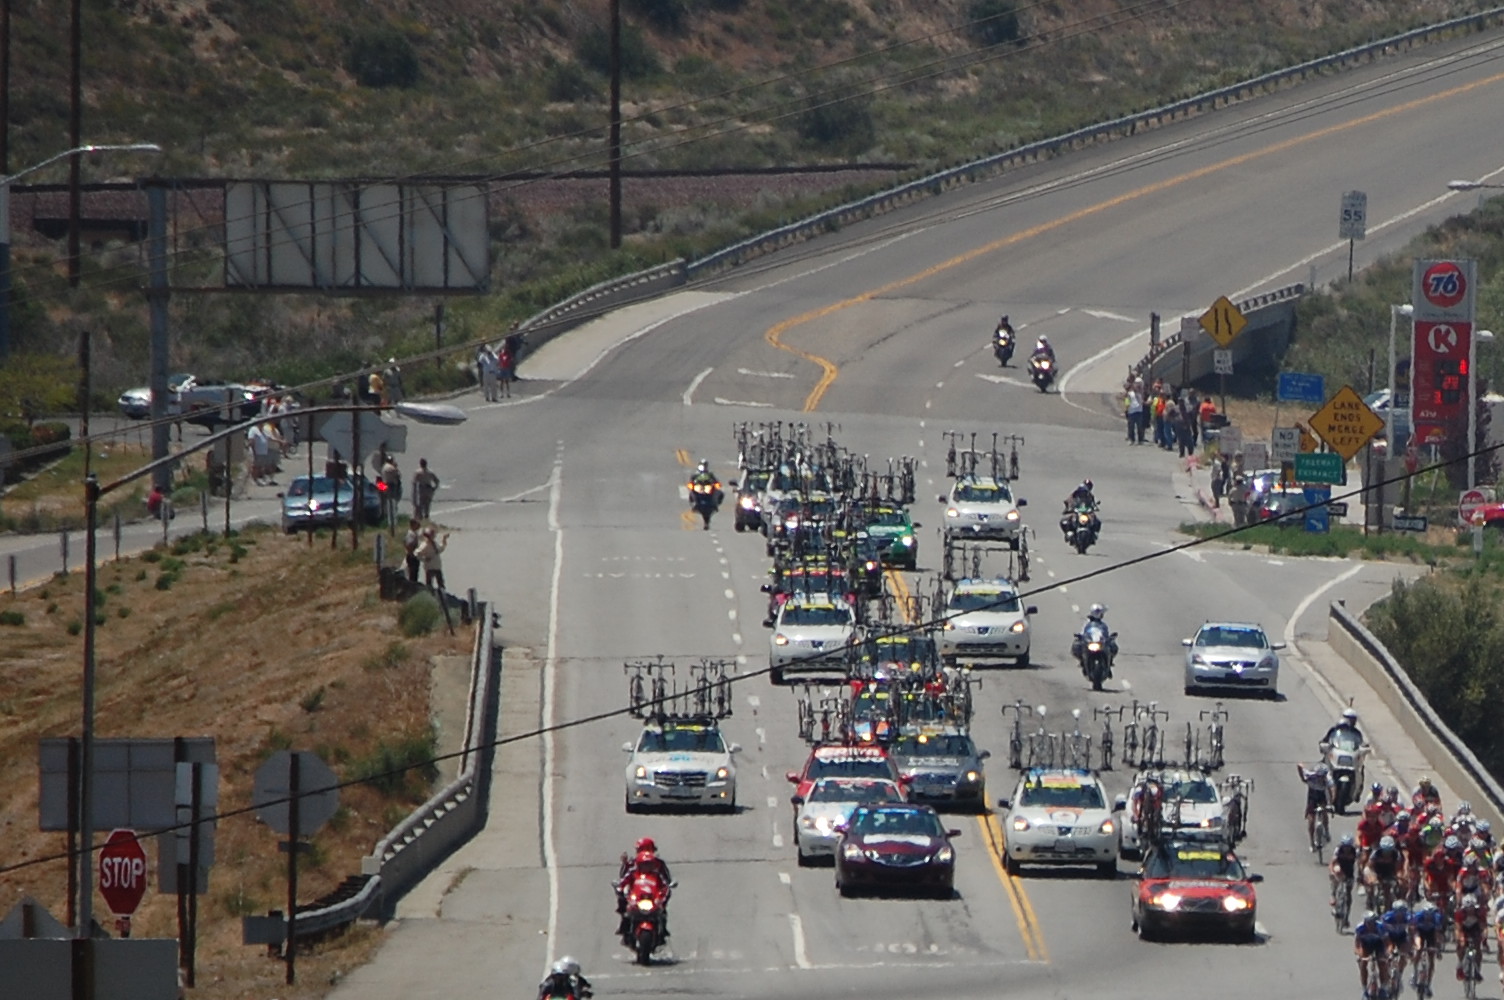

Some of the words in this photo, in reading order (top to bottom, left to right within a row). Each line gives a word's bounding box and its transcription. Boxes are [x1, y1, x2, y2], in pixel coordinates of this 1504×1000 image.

[1343, 209, 1362, 222] 55
[1429, 271, 1459, 296] 76
[1428, 324, 1457, 353] K
[1333, 401, 1360, 410] LANE
[1333, 412, 1361, 422] ENDS
[1328, 424, 1365, 434] MERGE
[1280, 431, 1294, 440] NO
[1333, 437, 1360, 446] LEFT
[101, 857, 144, 889] STOP
